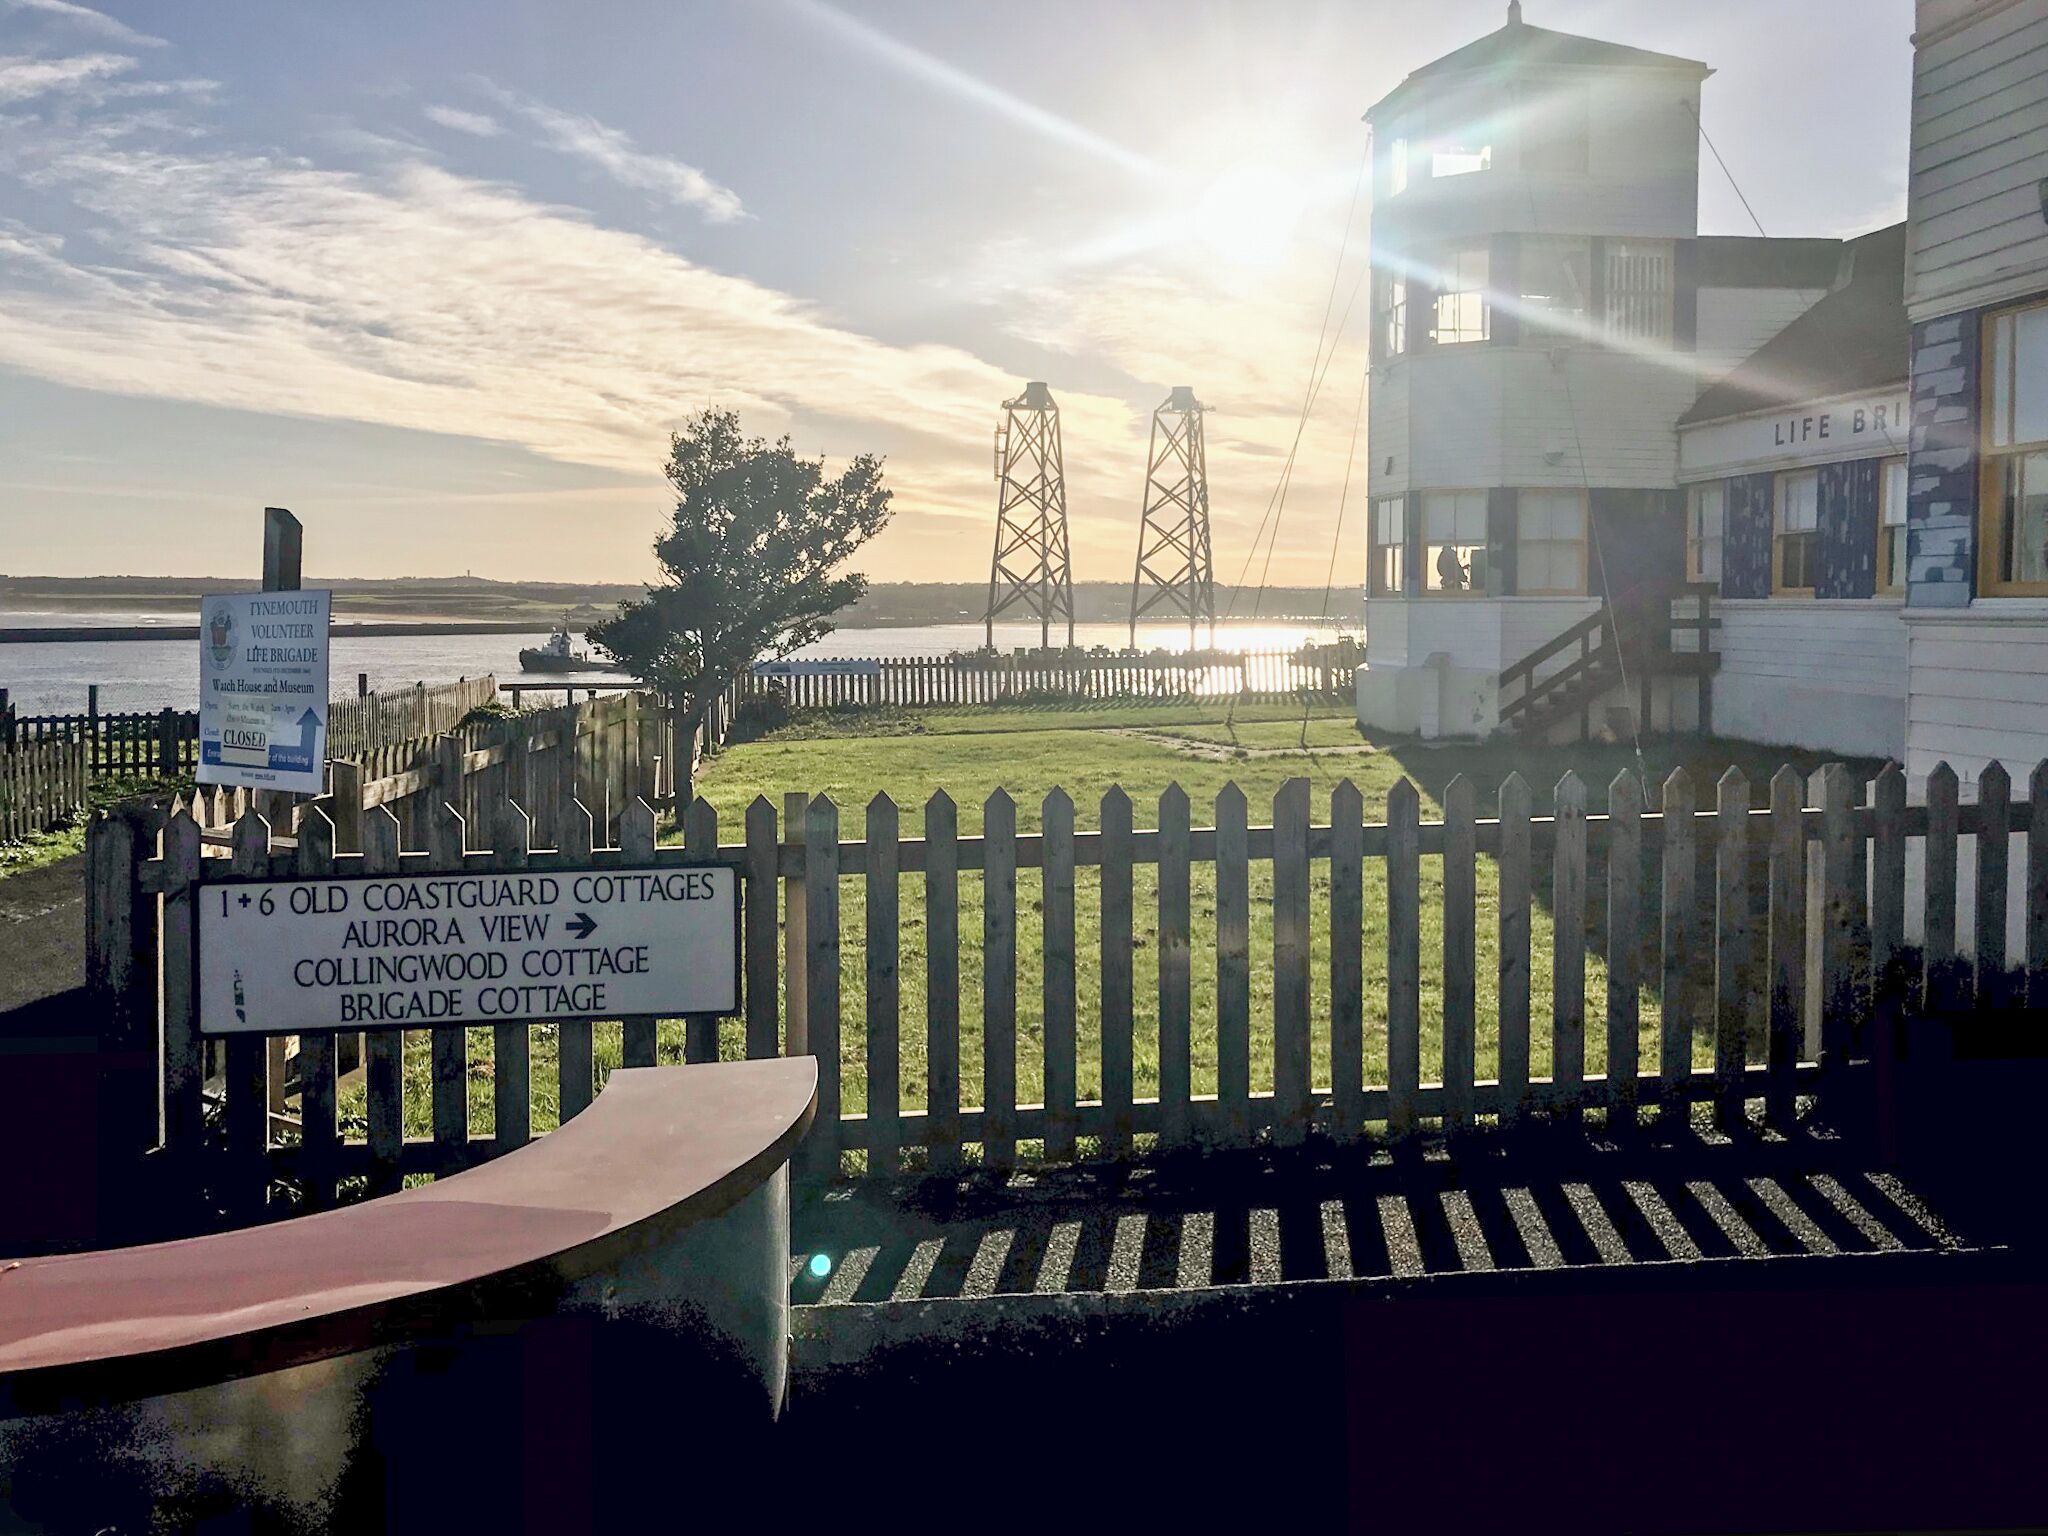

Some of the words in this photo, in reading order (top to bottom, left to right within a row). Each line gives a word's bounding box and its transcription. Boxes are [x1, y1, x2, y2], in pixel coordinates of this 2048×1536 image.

[1775, 414, 1830, 446] LIFE
[250, 599, 318, 616] TYNEMOUTH
[252, 623, 314, 640] VOLUNTEER
[246, 646, 268, 663] LIFE
[270, 647, 318, 663] BRIGADE
[212, 679, 236, 692] Watch
[237, 679, 262, 693] House
[263, 679, 278, 693] and
[279, 680, 315, 694] Museum
[223, 729, 266, 747] CLOSED
[290, 885, 349, 915] OLD
[363, 877, 560, 912] COASTGUARD
[572, 873, 715, 903] COTTAGES
[341, 916, 465, 949] AURORA
[481, 913, 551, 943] VIEW
[293, 950, 508, 987] COLLINGWOOD
[521, 945, 649, 977] COTTAGE
[340, 988, 463, 1022] BRIGADE
[477, 983, 606, 1016] COTTAGE
